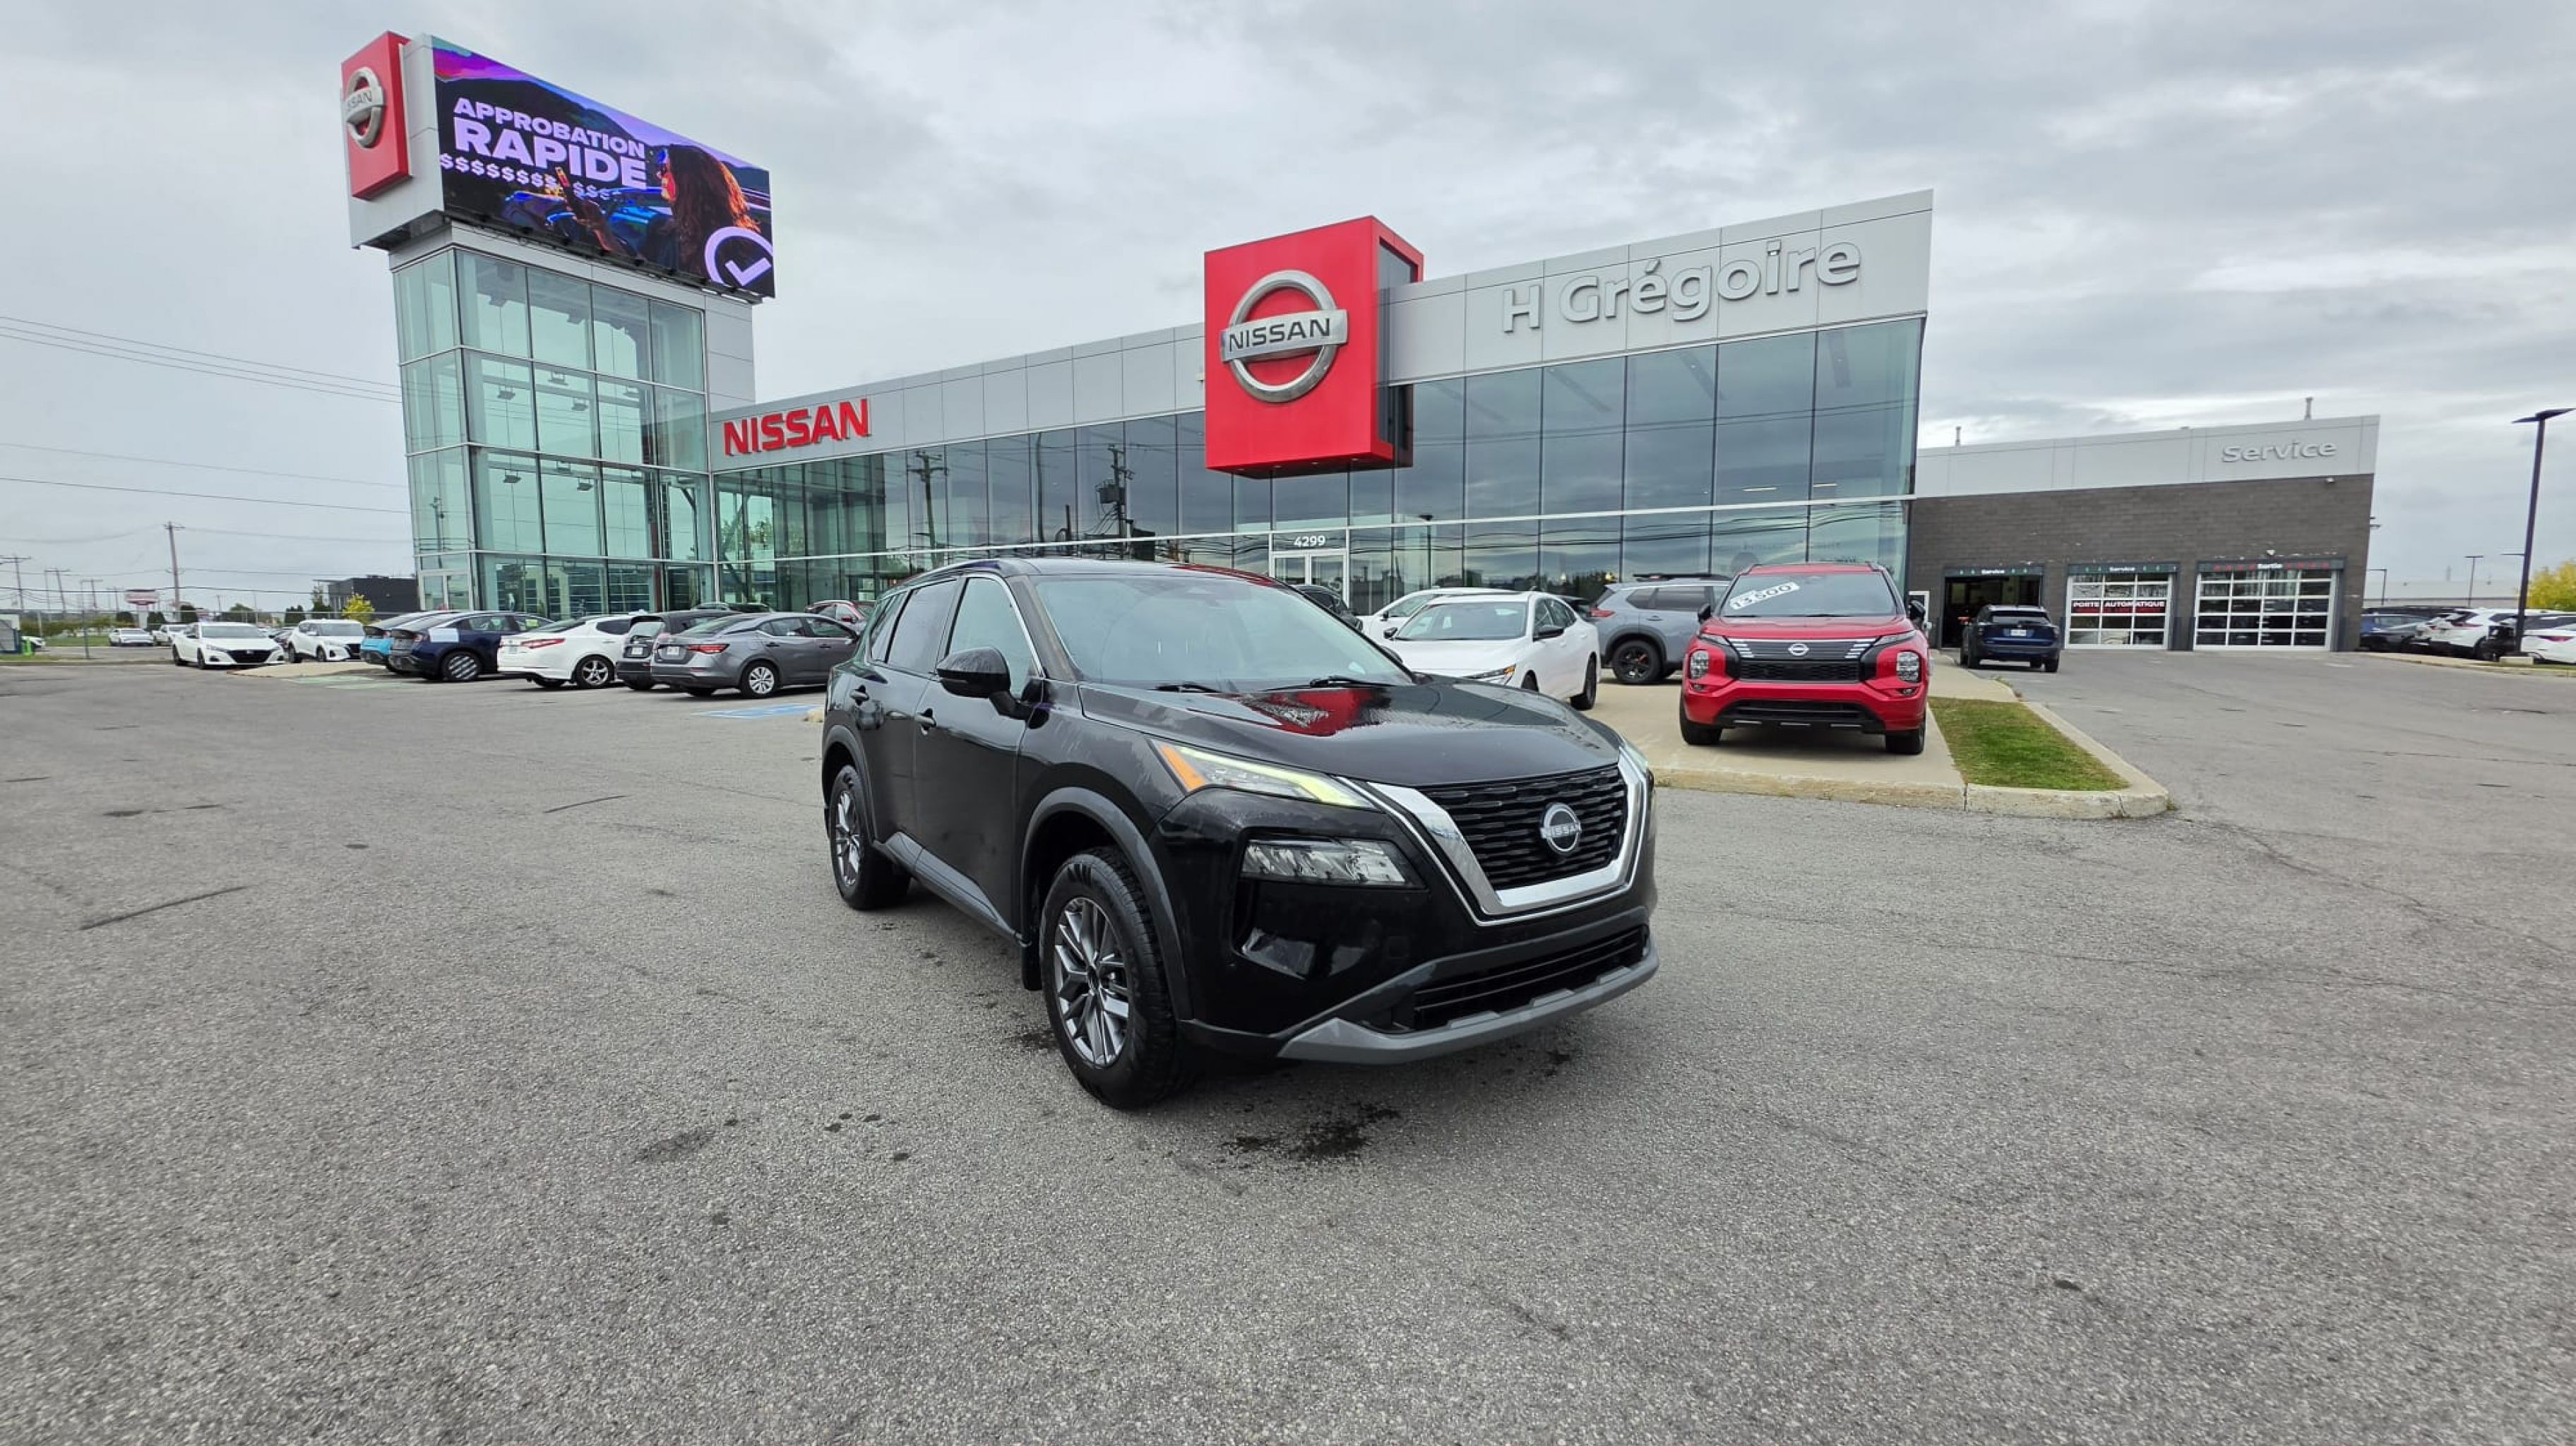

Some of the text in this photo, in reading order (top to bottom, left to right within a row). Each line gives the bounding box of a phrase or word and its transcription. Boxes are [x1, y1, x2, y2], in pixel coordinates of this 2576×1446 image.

[453, 97, 646, 159] APPROBATION
[453, 116, 647, 189] RAPIDE
[1503, 239, 1861, 333] H Grégoire
[1229, 318, 1330, 352] NISSAN
[724, 398, 869, 456] NISSAN
[2222, 440, 2337, 463] Service
[1294, 535, 1325, 547] 4299
